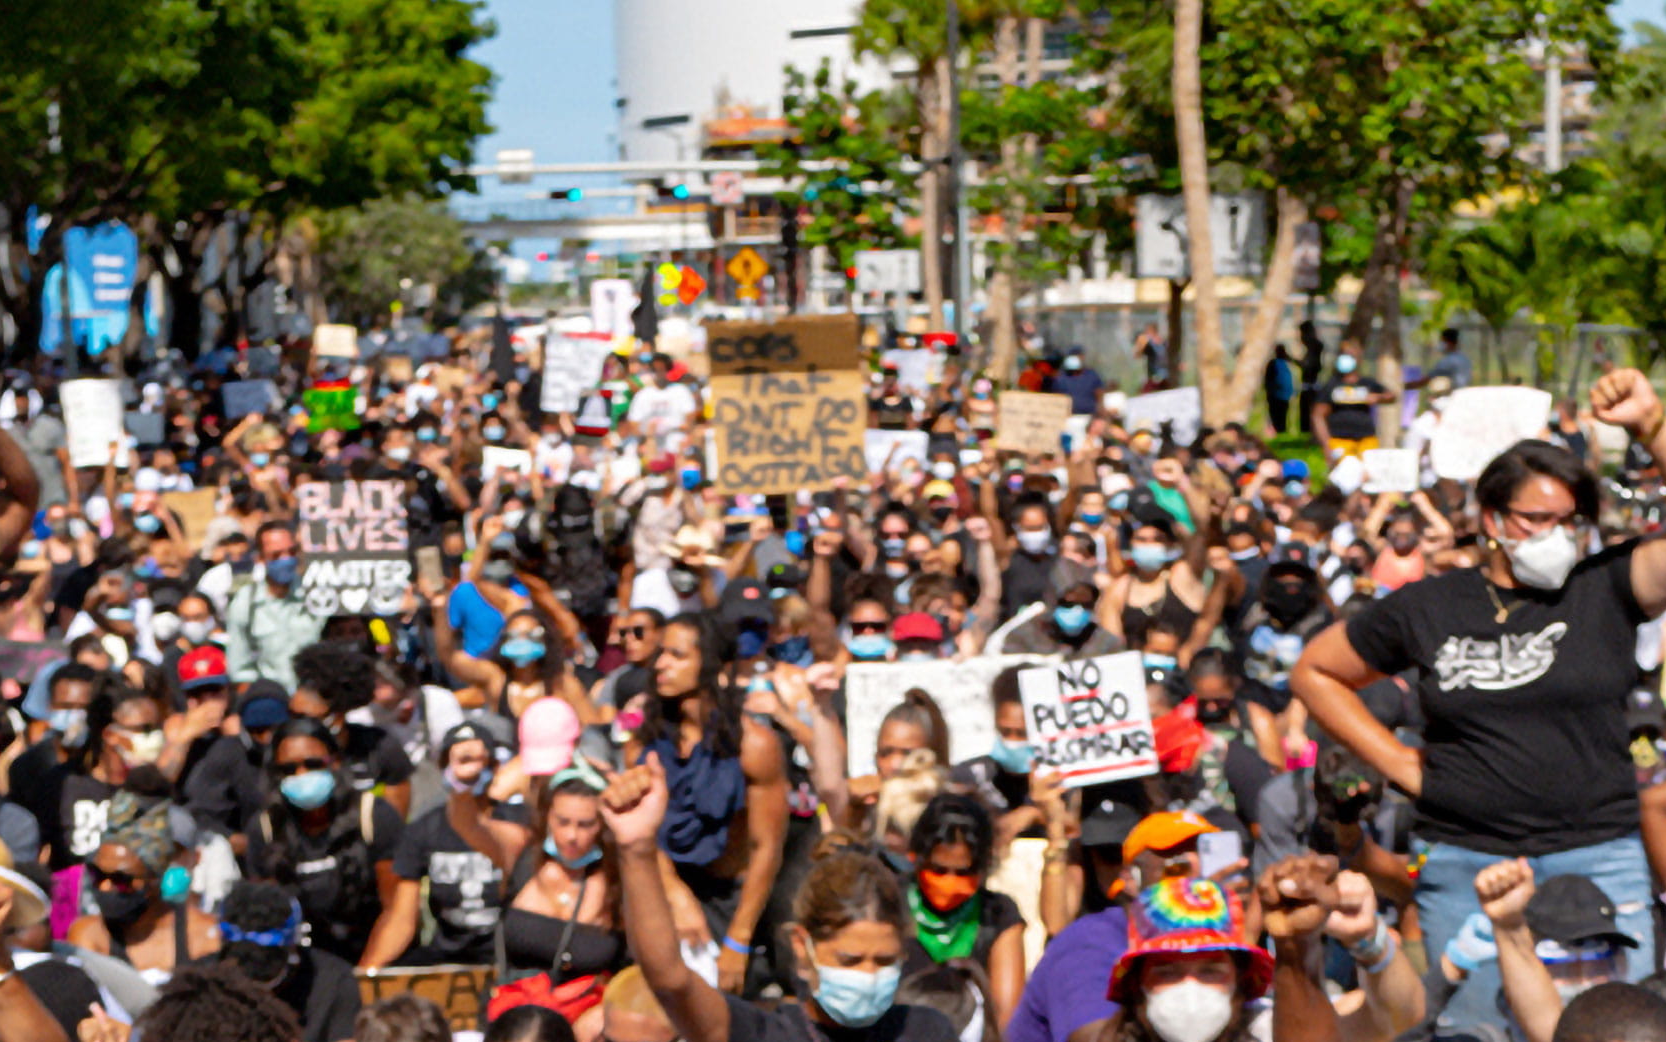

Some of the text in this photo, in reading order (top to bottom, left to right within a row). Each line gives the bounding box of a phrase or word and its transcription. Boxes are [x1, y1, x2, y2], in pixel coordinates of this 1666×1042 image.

[296, 480, 407, 520] BLACK
[298, 518, 408, 552] LIVES
[1056, 659, 1101, 692] NO
[1033, 692, 1130, 732] PUEDO
